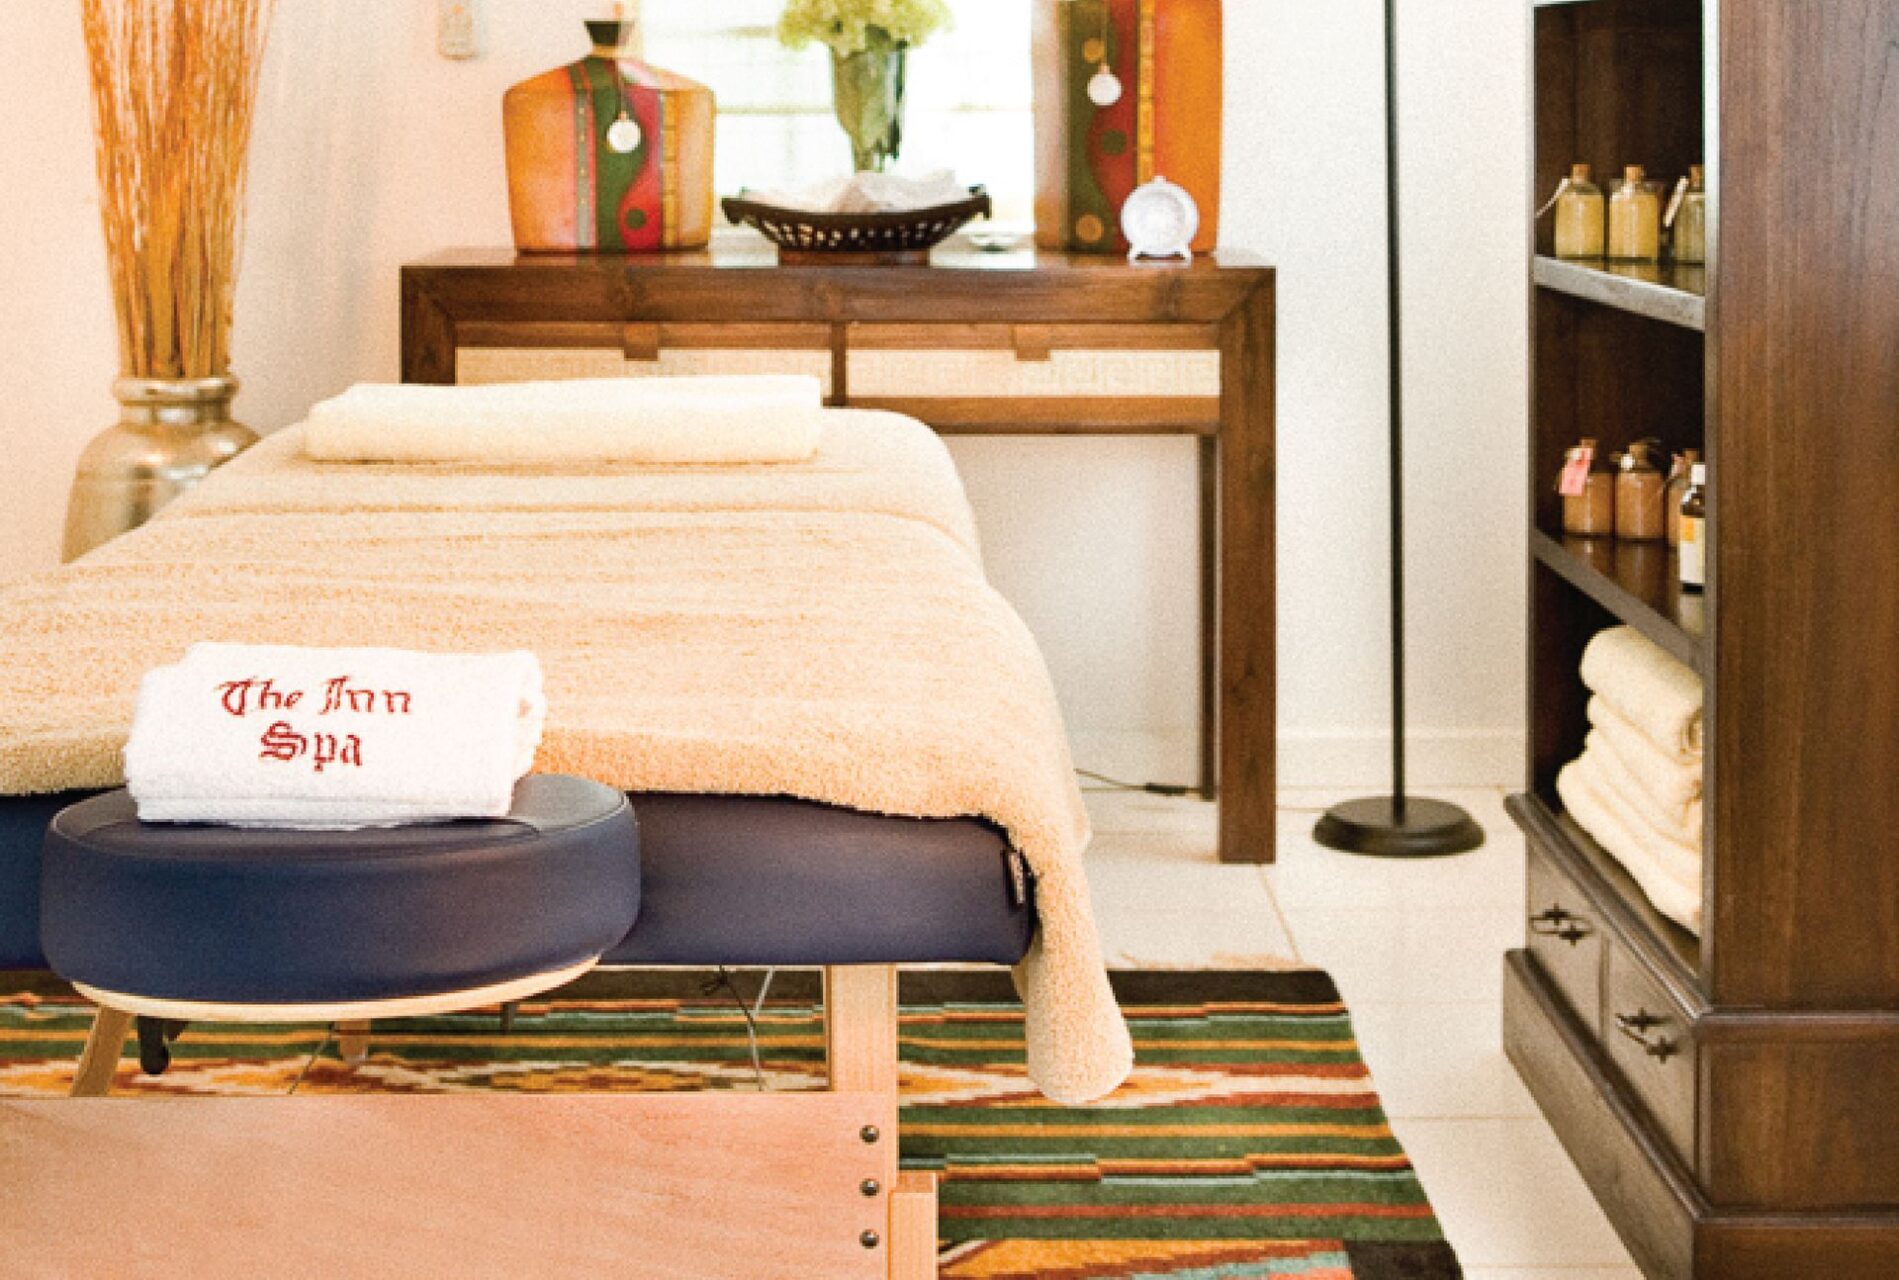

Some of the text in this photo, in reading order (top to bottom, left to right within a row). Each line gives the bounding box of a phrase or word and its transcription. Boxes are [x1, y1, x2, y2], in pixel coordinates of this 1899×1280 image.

[216, 675, 412, 716] The Inn
[259, 720, 363, 772] Spa
